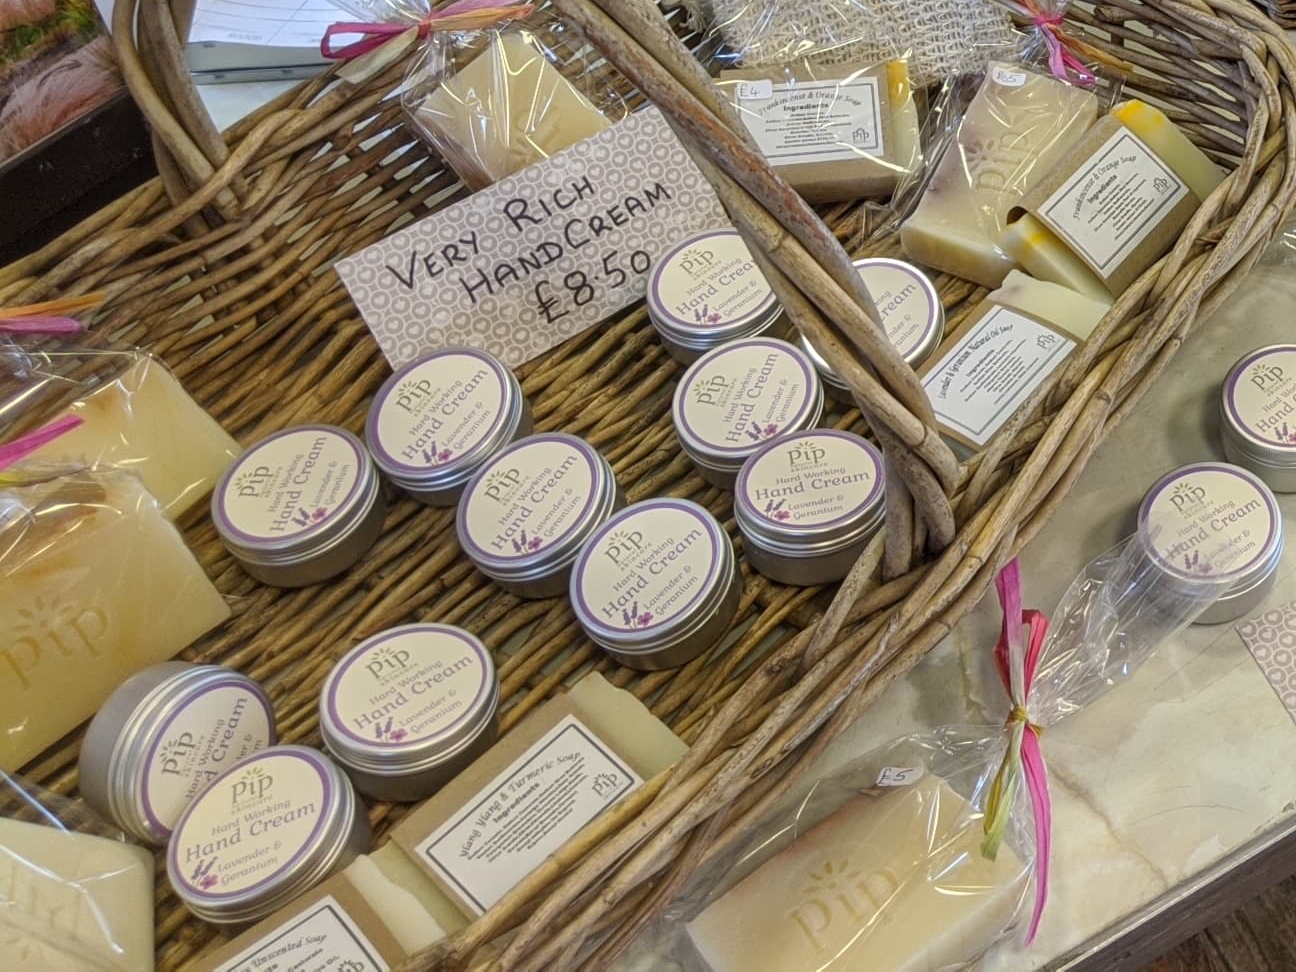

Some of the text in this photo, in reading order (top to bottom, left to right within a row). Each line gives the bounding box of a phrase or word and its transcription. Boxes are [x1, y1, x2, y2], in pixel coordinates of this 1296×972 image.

[386, 176, 595, 290] VERY RICH
[680, 251, 714, 274] pip
[676, 259, 755, 315] Hand Crea
[396, 379, 431, 412] pip
[697, 376, 730, 405] pip
[1250, 367, 1284, 392] pip
[401, 369, 488, 460] Hand Cream
[725, 354, 779, 443] Hand Cream
[1263, 396, 1285, 413] Hard
[1256, 402, 1294, 433] Hand
[788, 448, 826, 466] pip
[239, 466, 273, 497] pip
[271, 436, 327, 531] Hand Cream
[484, 468, 520, 502] pip
[756, 471, 870, 500] Hand Cream
[776, 467, 846, 484] Hard Working
[491, 454, 578, 550] Hand Cream
[788, 498, 834, 510] Lavender
[1170, 487, 1206, 512] pip
[1167, 499, 1261, 558] Hand Cream
[604, 531, 643, 564] pip
[602, 528, 702, 618] Hand Cream
[612, 538, 675, 592] Hard Working
[643, 572, 683, 610] Lavender
[366, 650, 410, 678] pip
[354, 655, 473, 730] Hand Cream
[212, 697, 248, 763] Cream
[161, 731, 196, 777] pip
[232, 775, 273, 804] pip
[878, 769, 915, 785] £5
[493, 783, 540, 823] Ingredients
[186, 802, 315, 864] Hand Cream
